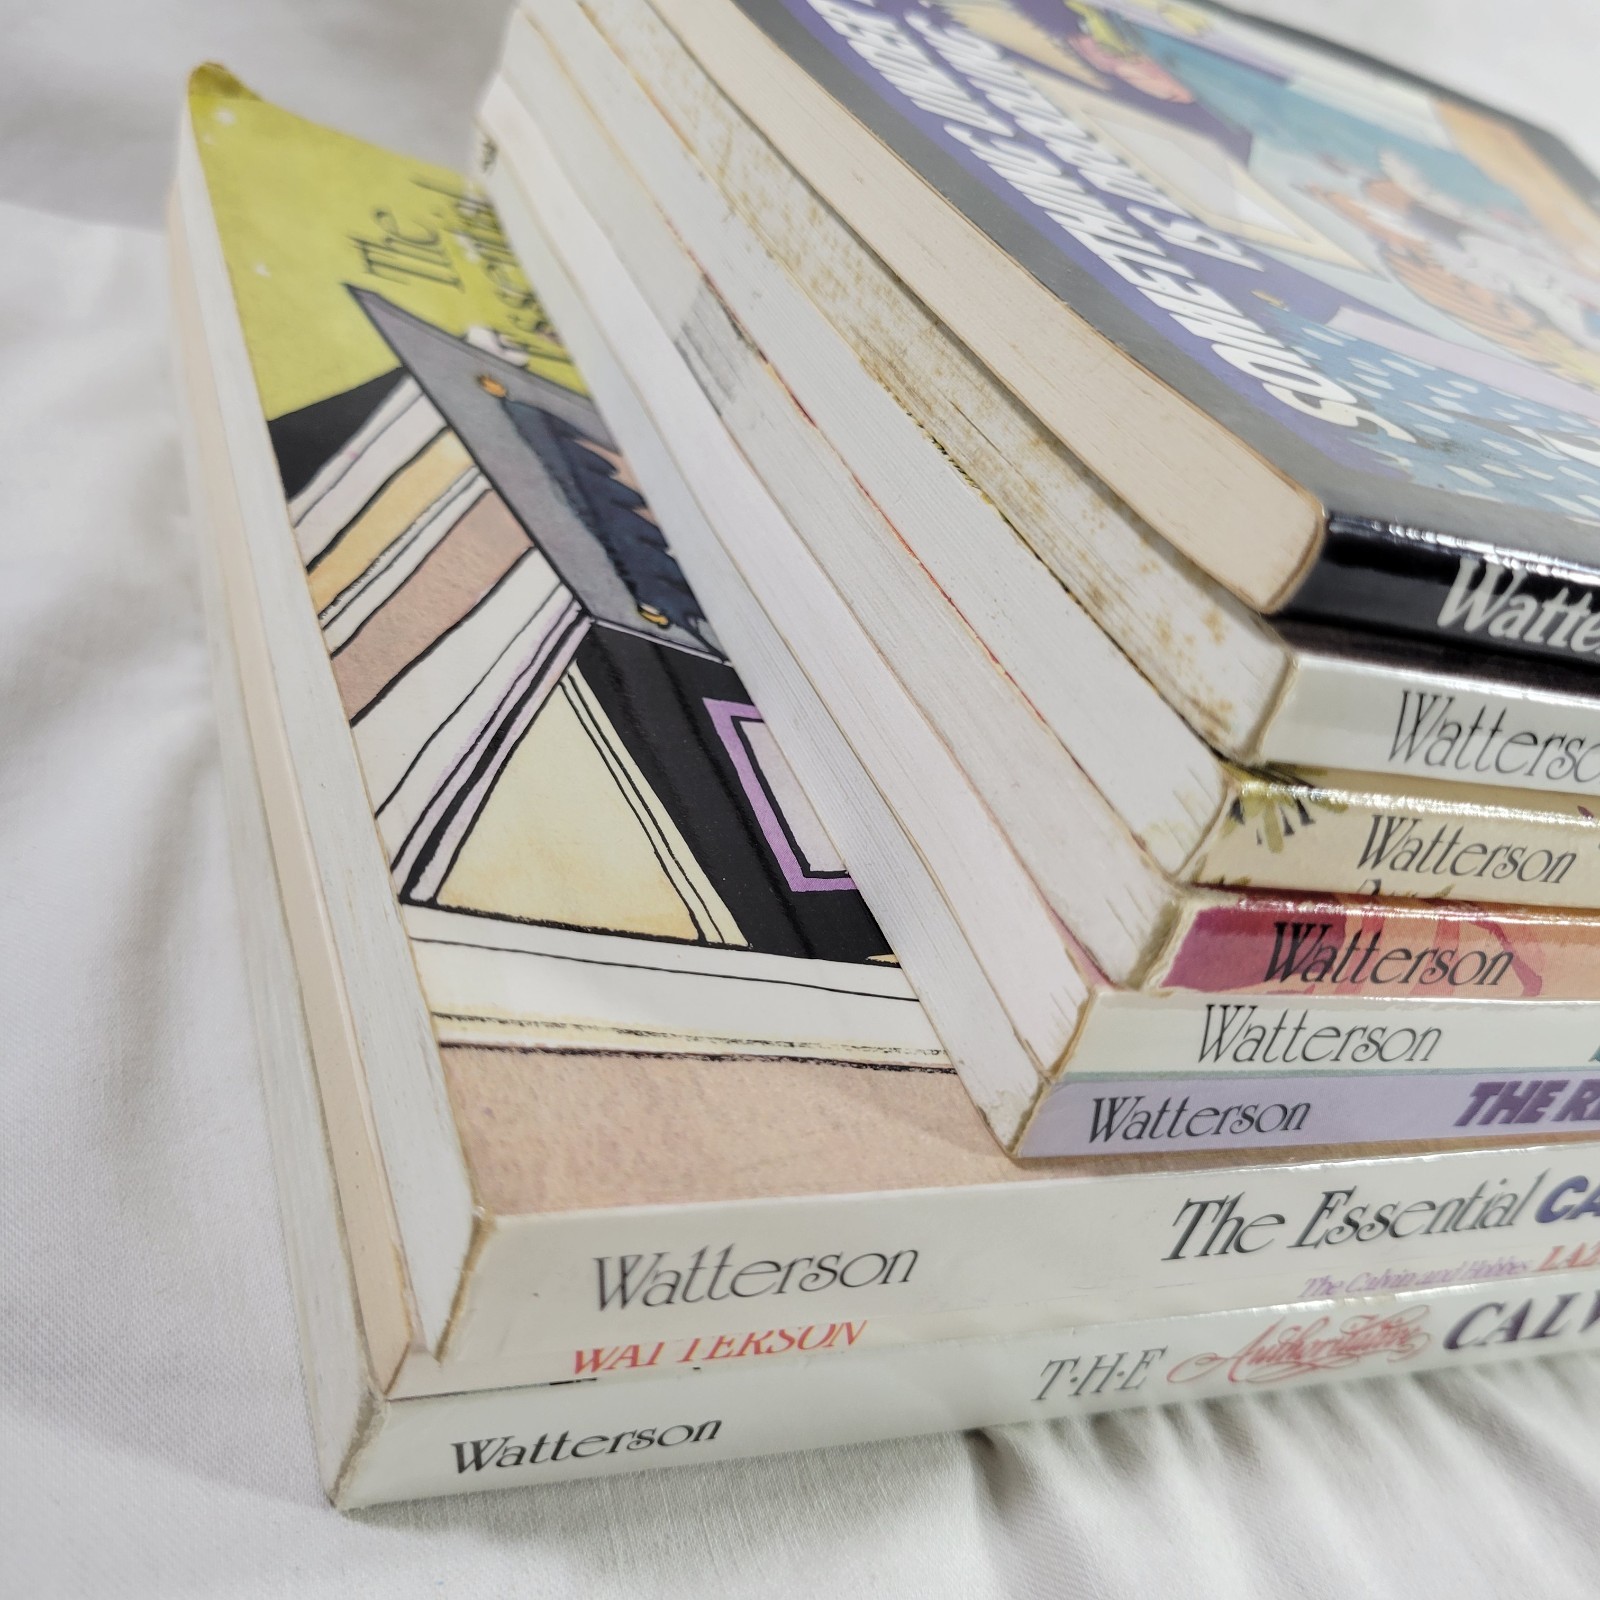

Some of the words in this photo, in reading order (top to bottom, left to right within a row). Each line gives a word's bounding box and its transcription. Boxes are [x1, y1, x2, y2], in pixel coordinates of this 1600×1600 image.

[346, 208, 465, 294] The
[944, 123, 1416, 443] SOMETHING
[1356, 814, 1577, 884] Watterson
[1263, 920, 1516, 988] Watterson
[1198, 1003, 1443, 1064] Watterson
[1088, 1096, 1311, 1145] Watterson
[1454, 1081, 1570, 1127] THE
[593, 1243, 919, 1312] Watterson
[1161, 1191, 1285, 1262] The
[1286, 1168, 1550, 1250] Essential
[451, 1419, 723, 1475] Watterson
